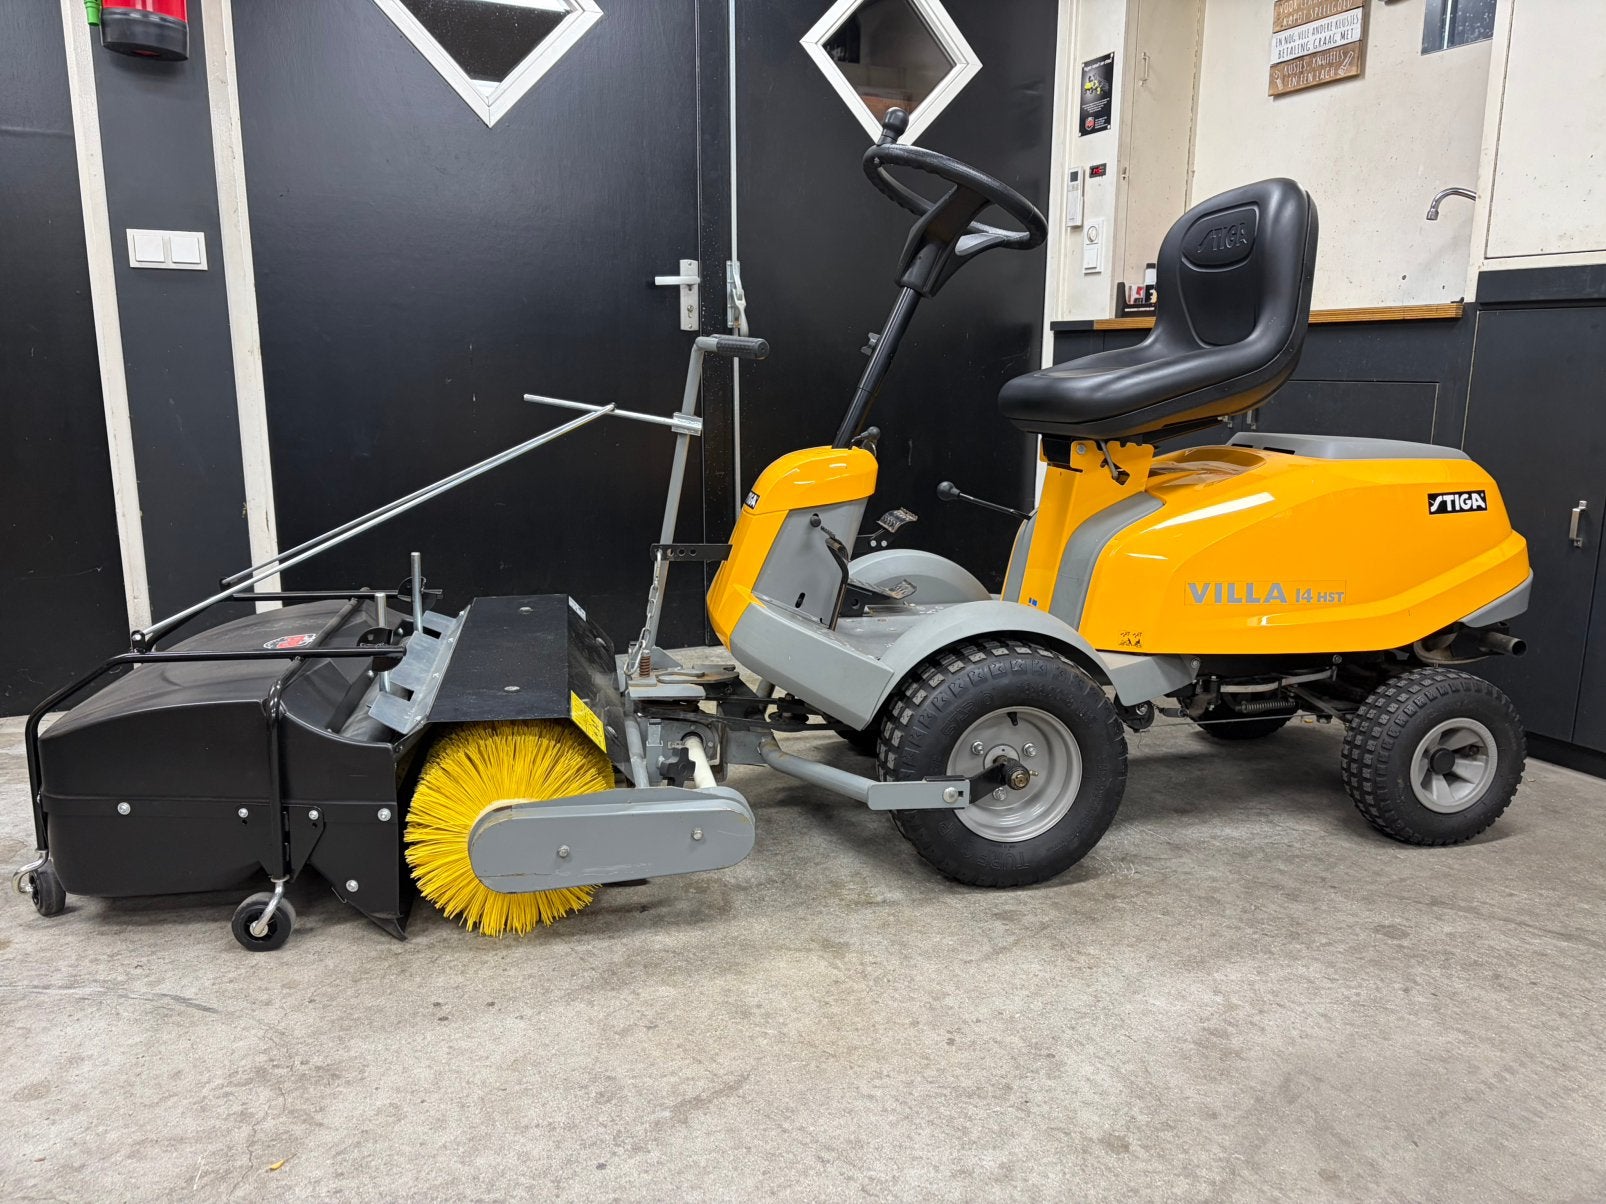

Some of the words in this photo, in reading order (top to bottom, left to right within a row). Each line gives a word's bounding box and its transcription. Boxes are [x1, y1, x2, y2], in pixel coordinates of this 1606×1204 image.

[1275, 37, 1283, 48] EN
[1284, 32, 1296, 45] NOG
[1311, 20, 1333, 37] ANDERE
[1334, 13, 1359, 30] KLUSJES
[1277, 41, 1311, 60] BETALING
[1312, 34, 1337, 50] GRAAG
[1340, 28, 1354, 41] MET
[1312, 50, 1344, 67] KNUFFELS
[1288, 76, 1298, 88] EN
[1316, 67, 1335, 81] LACH
[1197, 222, 1248, 253] STIGA
[1429, 493, 1486, 512] STIGA
[1187, 582, 1288, 604] VILLA
[1317, 591, 1345, 603] HST
